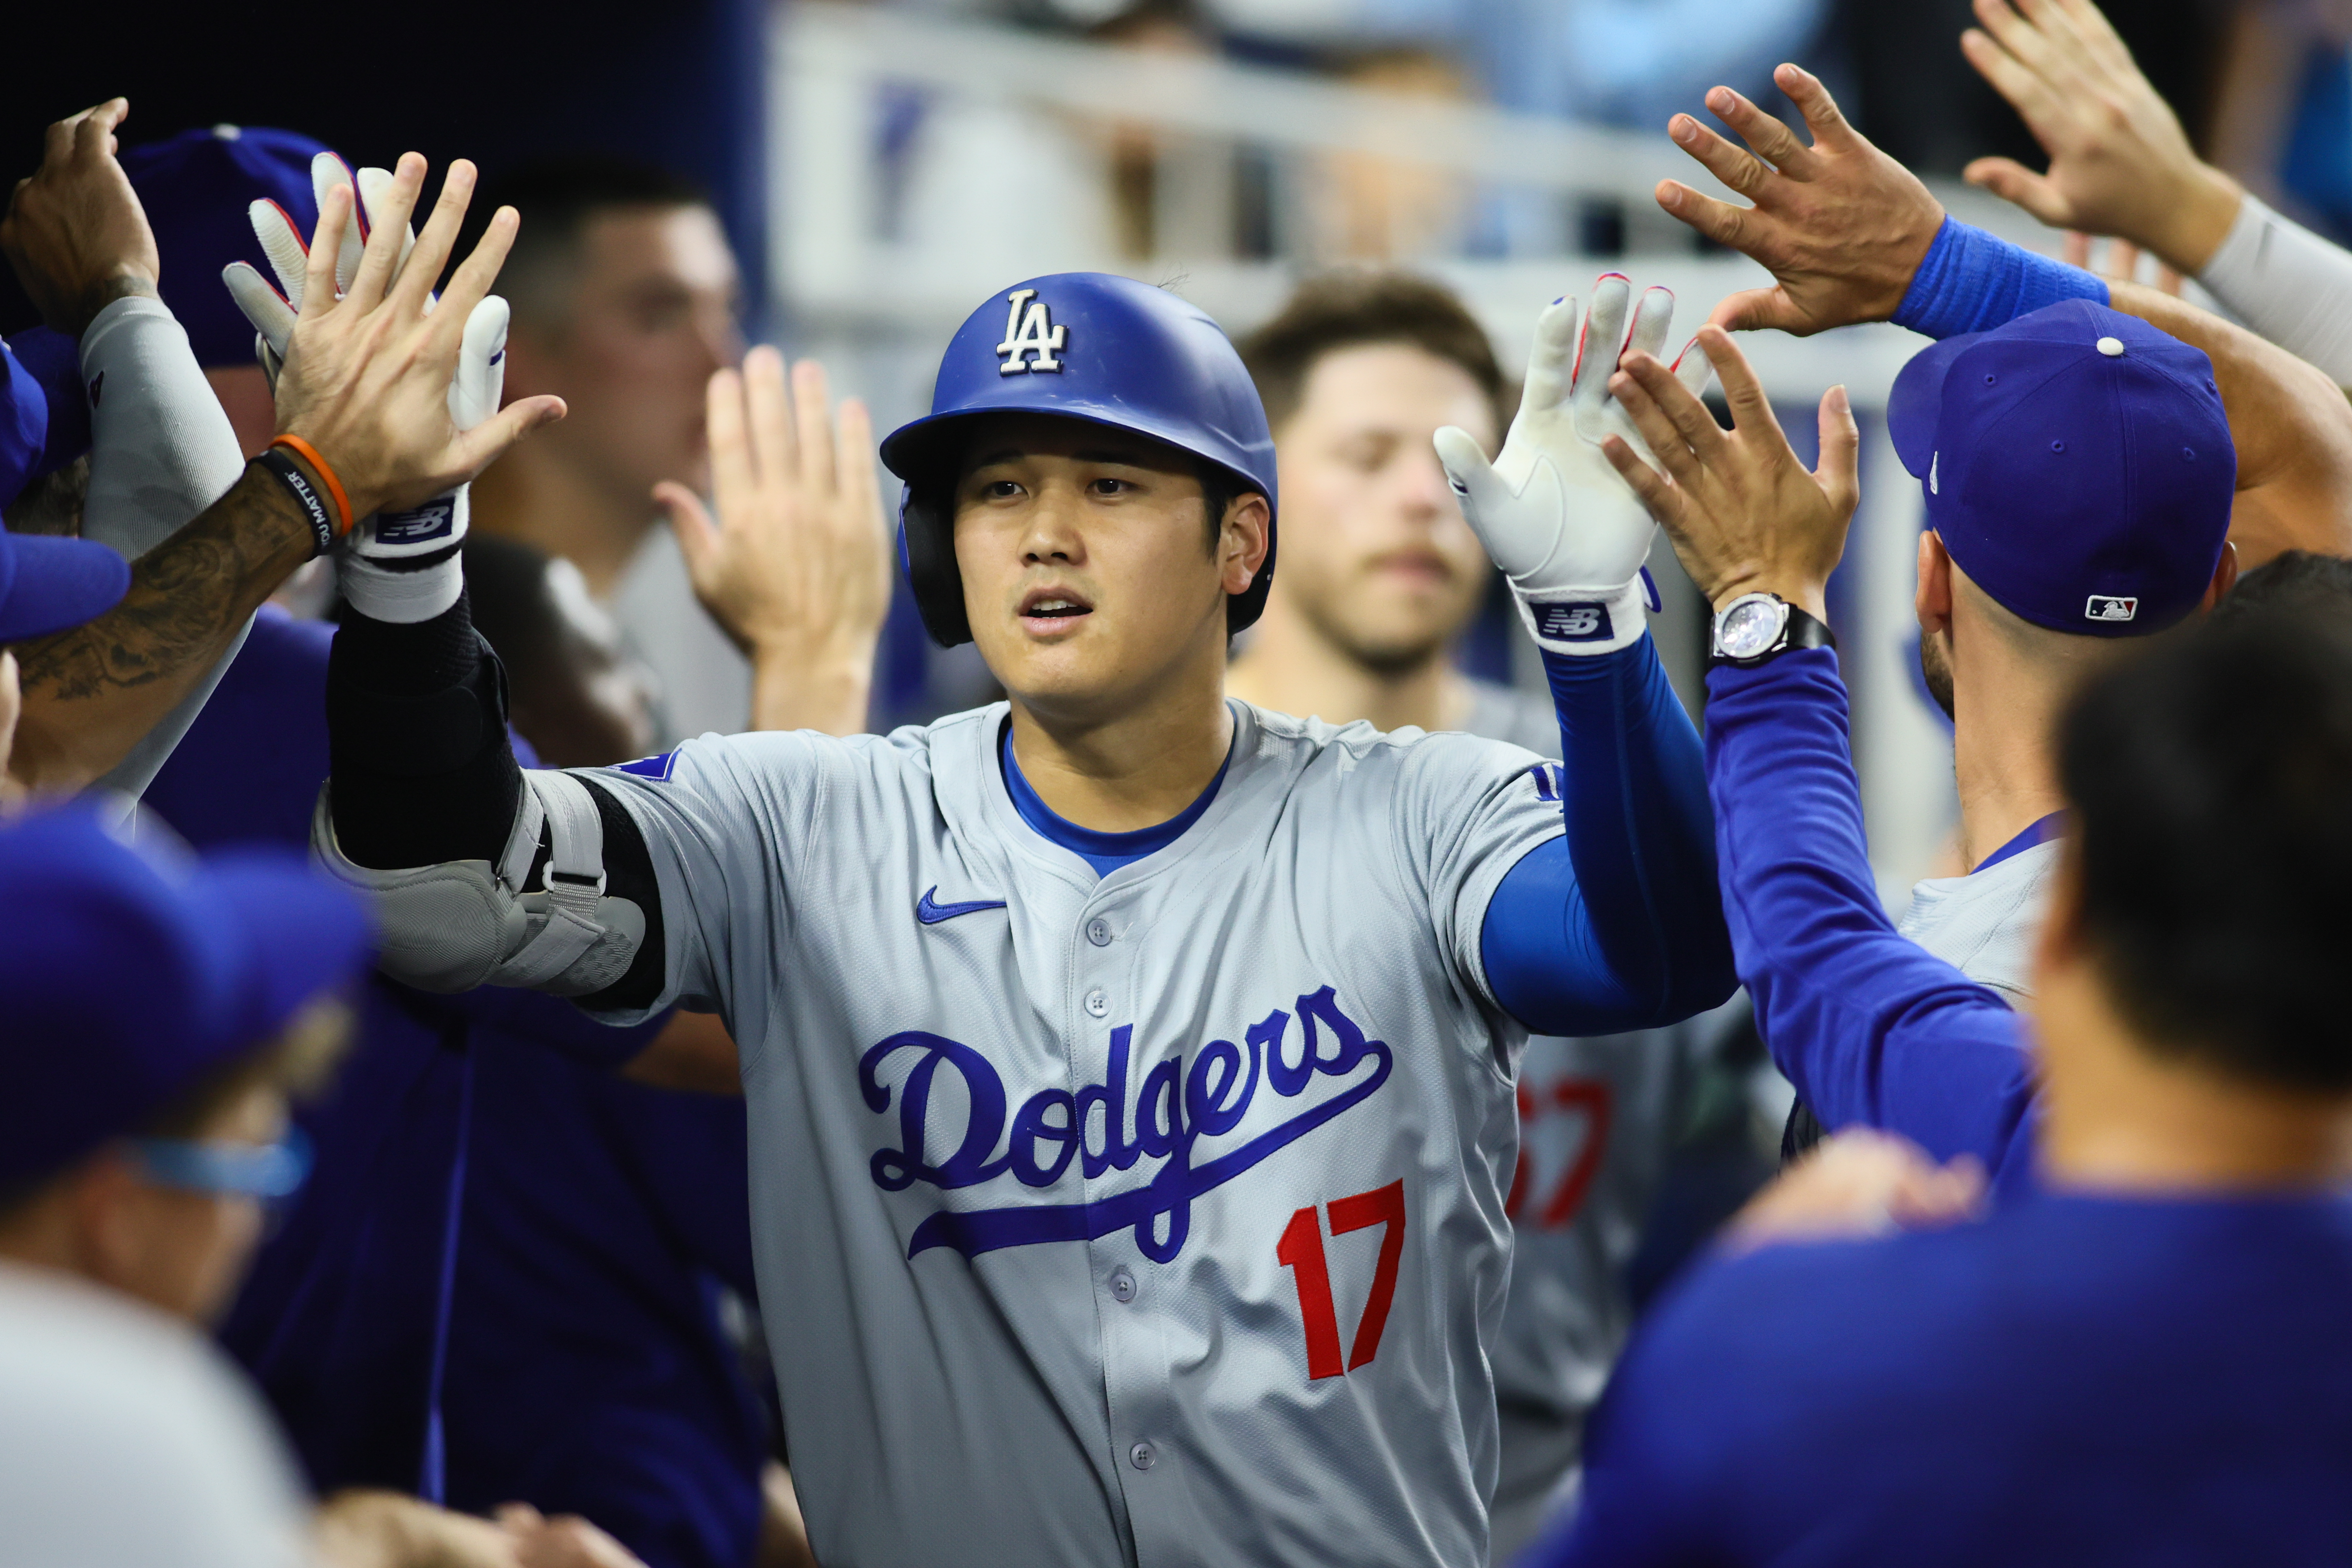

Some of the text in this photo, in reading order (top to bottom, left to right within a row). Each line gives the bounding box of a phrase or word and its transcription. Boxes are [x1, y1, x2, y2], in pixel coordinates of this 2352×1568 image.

[997, 289, 1068, 376] LA
[288, 471, 326, 524] MATTER
[1543, 608, 1601, 635] NB
[858, 984, 1393, 1264] Dodgers
[1276, 1178, 1406, 1380] 17
